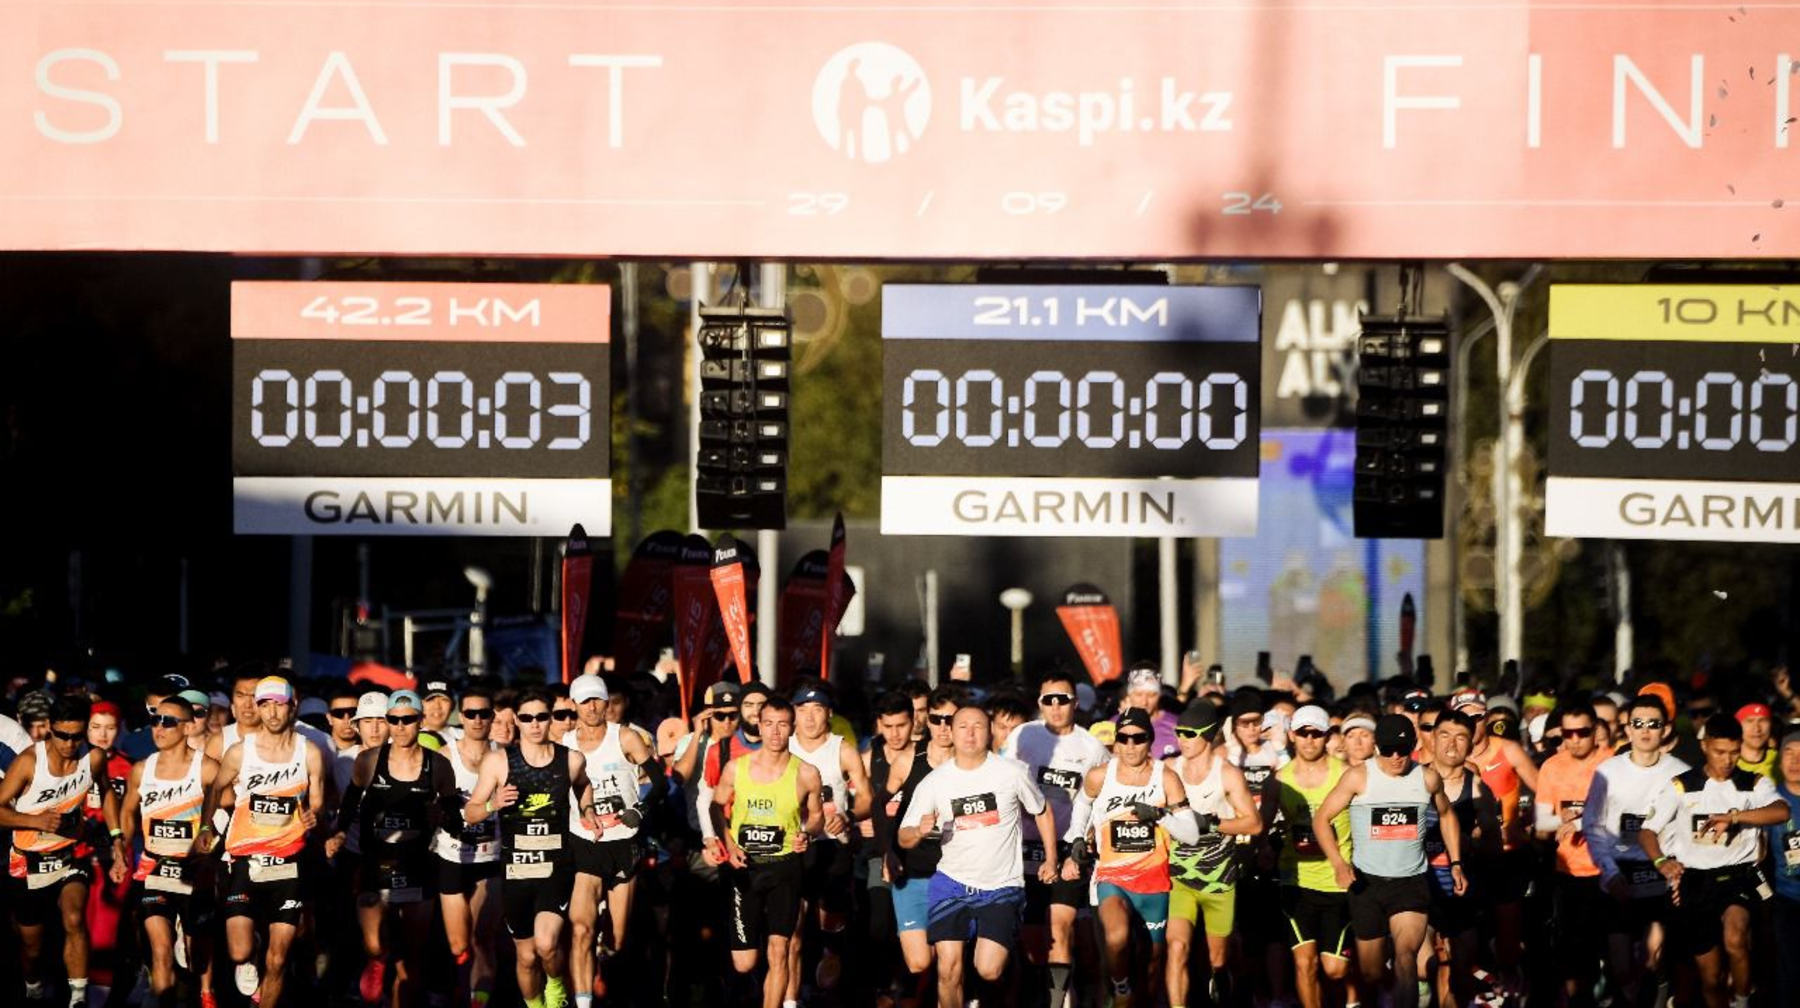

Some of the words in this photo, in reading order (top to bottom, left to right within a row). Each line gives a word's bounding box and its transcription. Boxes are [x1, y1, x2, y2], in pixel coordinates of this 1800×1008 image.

[33, 47, 664, 148] START
[960, 76, 1234, 147] Kaspi.kz
[787, 192, 850, 216] 29
[1001, 192, 1068, 216] 09
[1220, 192, 1284, 216] 24
[301, 297, 433, 326] 42.2
[448, 298, 541, 327] KM
[972, 297, 1059, 326] 21.1
[1076, 297, 1170, 327] KM
[1657, 297, 1718, 326] 10
[251, 369, 592, 450] 00:00:03
[902, 368, 1248, 450] 00:00:00
[303, 490, 529, 526] GARMIN
[952, 490, 1176, 526] GARMIN
[253, 801, 291, 815] E78-1
[962, 800, 987, 815] 918
[1382, 813, 1409, 826] 924
[154, 825, 186, 839] E13-1
[526, 824, 550, 836] E71
[745, 830, 776, 843] 1057
[1116, 826, 1150, 839] 1496
[512, 851, 545, 864] E71-1
[160, 865, 183, 879] E13
[391, 875, 408, 888] E3
